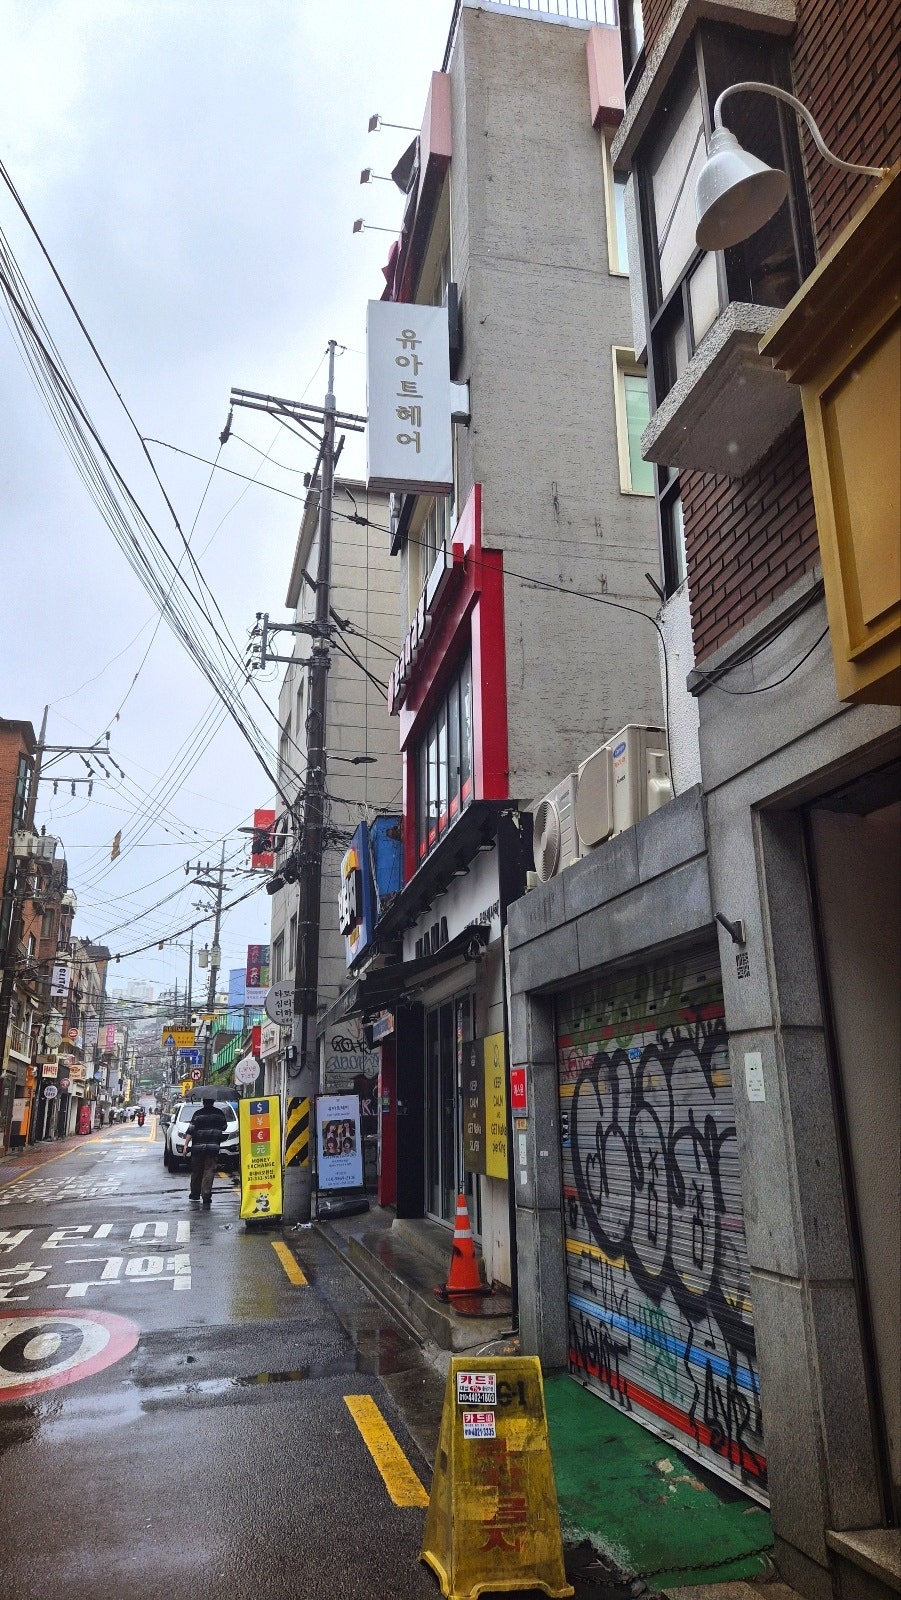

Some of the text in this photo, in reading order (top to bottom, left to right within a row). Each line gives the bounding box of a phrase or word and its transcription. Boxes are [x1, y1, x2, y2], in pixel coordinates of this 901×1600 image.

[395, 328, 424, 454] 유아트헤어
[275, 998, 295, 1008] 심리
[247, 1161, 275, 1169] EXCHANGE
[460, 1375, 487, 1384] 카드
[464, 1413, 486, 1423] 카드
